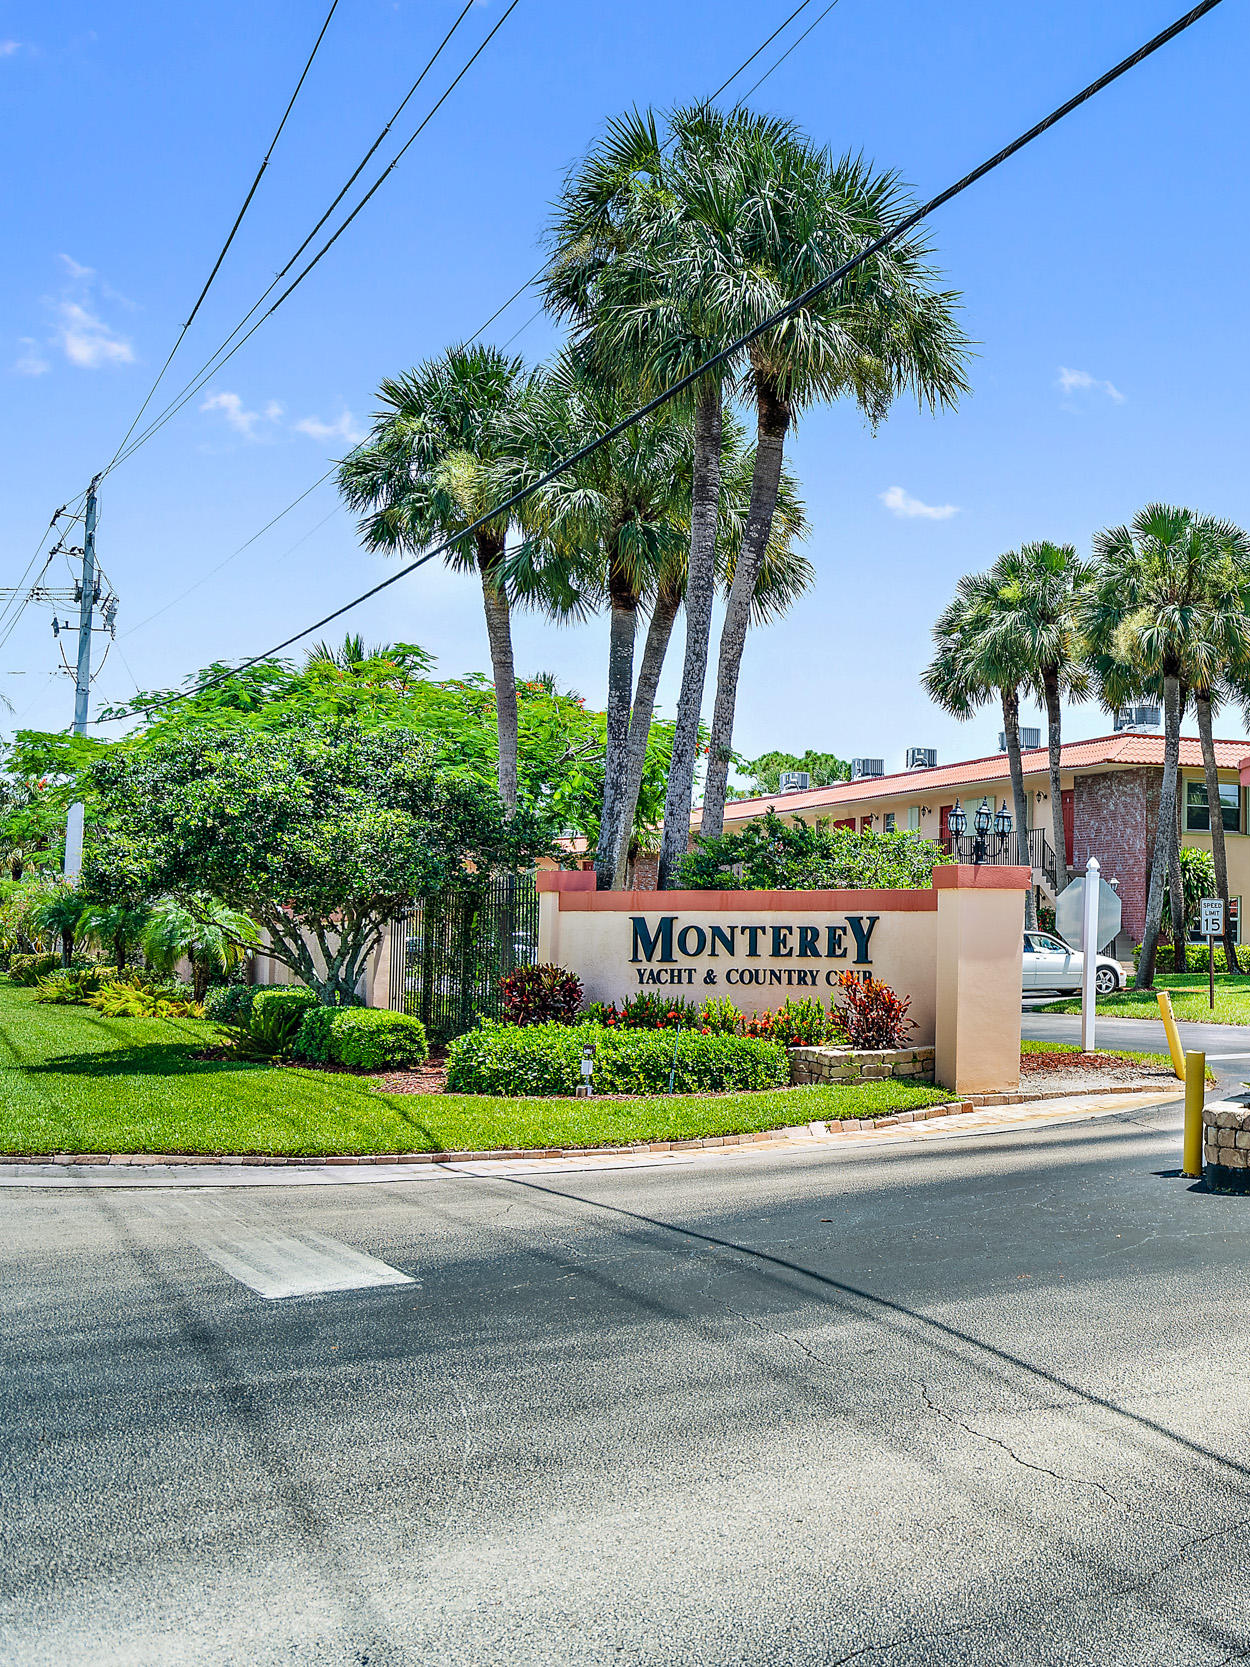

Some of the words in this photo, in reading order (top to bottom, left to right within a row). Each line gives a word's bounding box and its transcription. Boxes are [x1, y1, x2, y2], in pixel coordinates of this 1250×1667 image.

[1204, 918, 1220, 931] 15
[628, 916, 880, 964] MONTEREY
[636, 968, 697, 985] YACHT
[703, 968, 718, 985] &
[725, 968, 821, 986] COUNTRY
